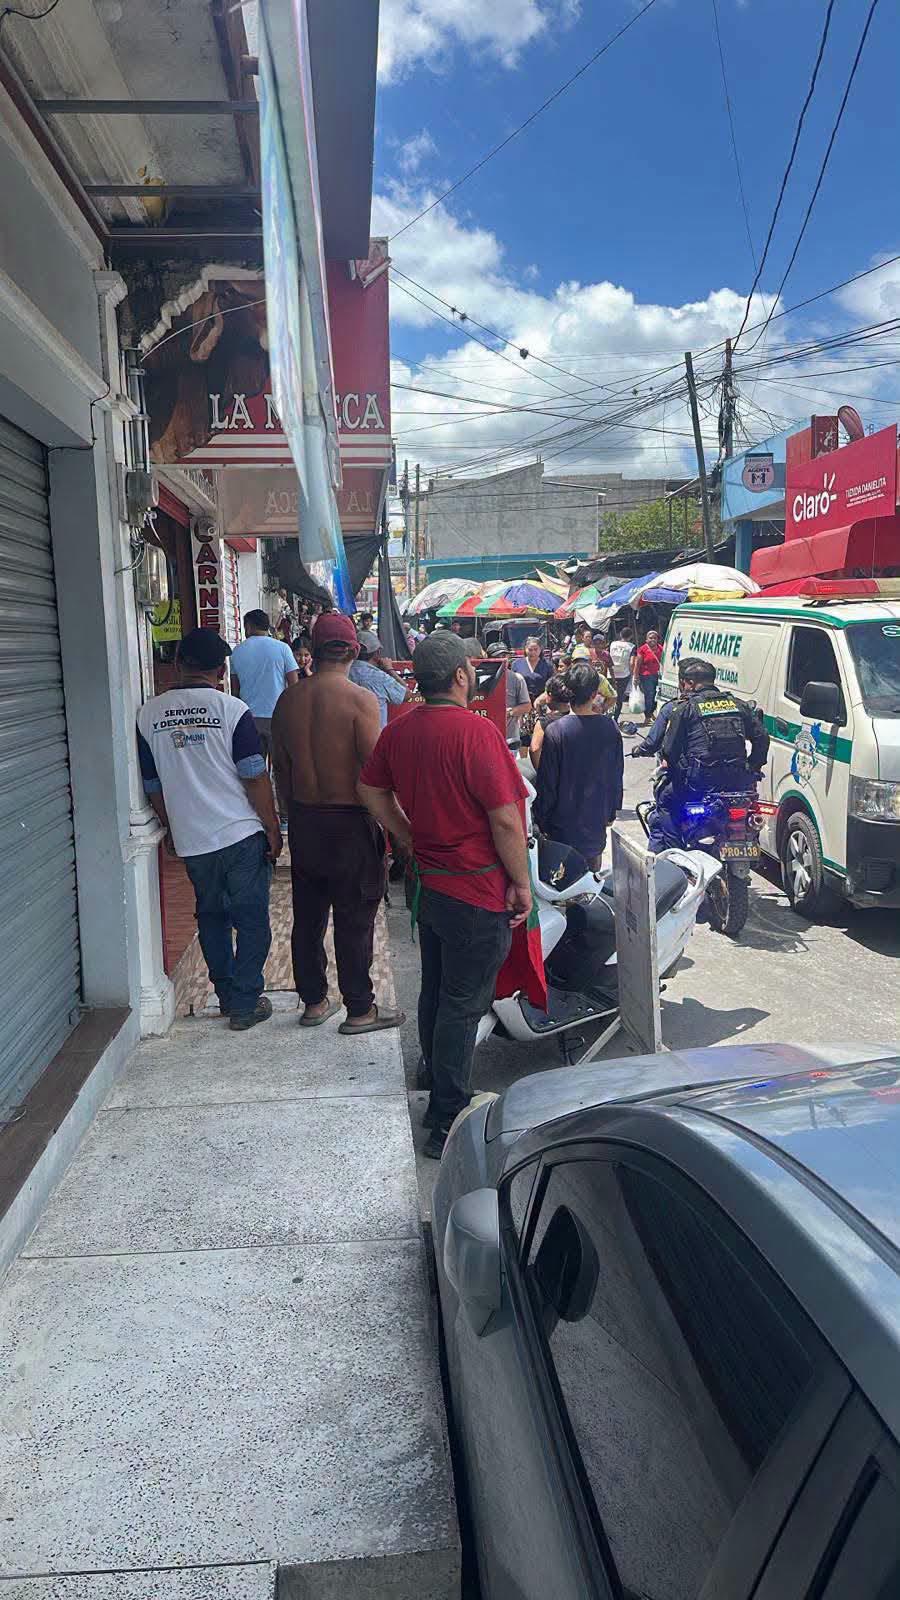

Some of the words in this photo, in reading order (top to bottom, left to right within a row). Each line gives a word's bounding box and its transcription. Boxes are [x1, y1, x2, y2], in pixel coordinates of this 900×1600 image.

[209, 393, 254, 429] LA
[793, 489, 831, 523] Claro
[688, 631, 742, 658] SANARATE
[698, 700, 736, 710] POLICIA
[165, 707, 207, 717] SERVICIO
[153, 722, 159, 730] Y
[160, 717, 221, 729] DESARROLLO
[186, 733, 206, 743] MUNI
